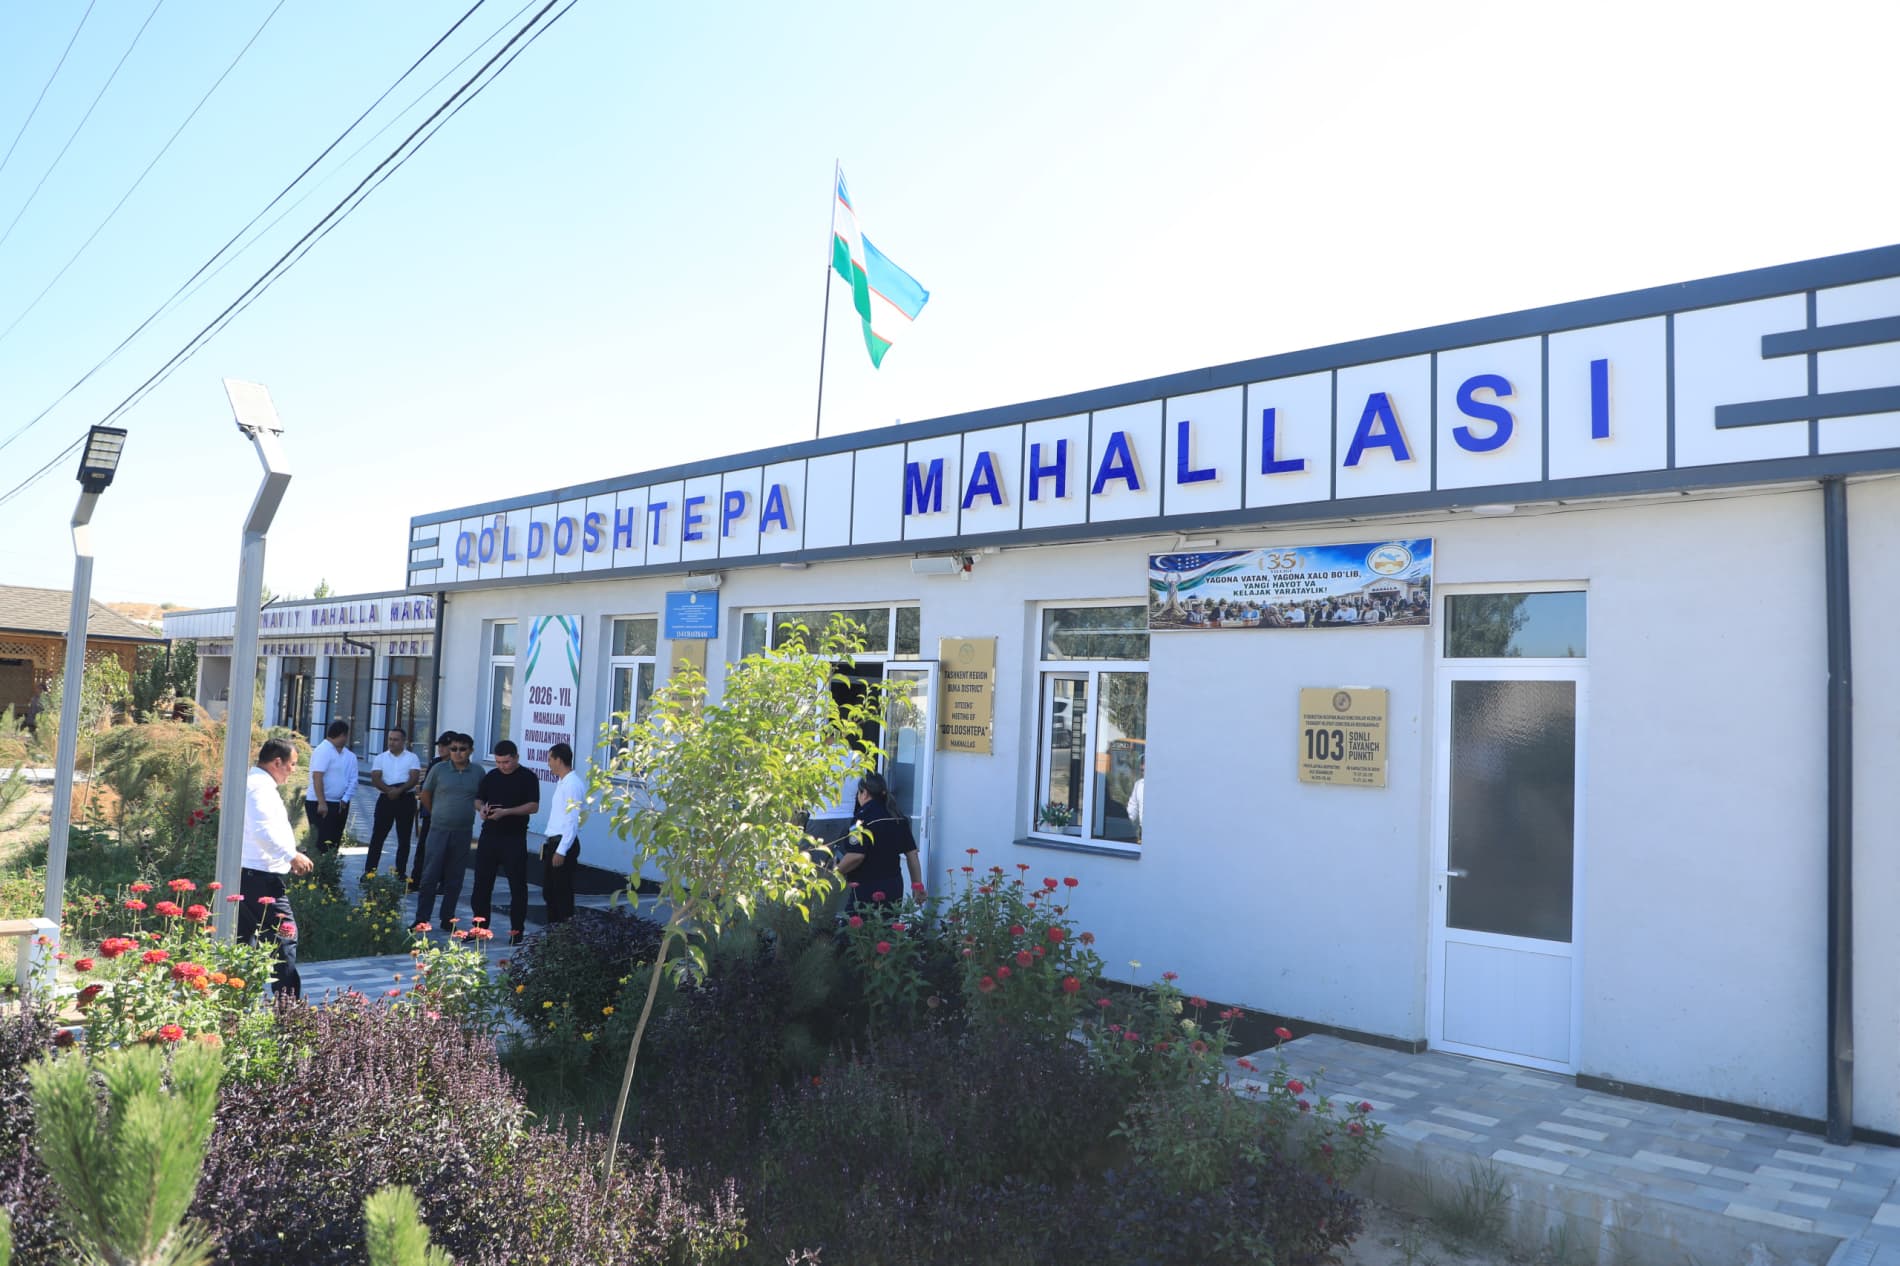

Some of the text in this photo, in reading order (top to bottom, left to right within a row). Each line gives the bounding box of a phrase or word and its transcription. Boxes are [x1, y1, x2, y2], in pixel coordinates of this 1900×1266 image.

[455, 357, 1610, 567] QO'LDOSHTEPA MAHALLASI
[1267, 552, 1296, 570] 35
[1205, 576, 1239, 584] YAGONA
[1273, 573, 1305, 581] YAGONA
[1307, 572, 1328, 580] XALQ
[1274, 587, 1328, 595] YARATAYLIK!
[311, 603, 377, 626] MAHALLA
[390, 599, 434, 622] MARK
[529, 686, 552, 705] 2026
[560, 688, 571, 706] YIL
[533, 712, 565, 726] MAHALLANI
[1349, 731, 1370, 741] SONLI
[1305, 728, 1344, 761] 103
[1349, 741, 1379, 752] TAYANCH
[1349, 752, 1373, 760] PUNKTI
